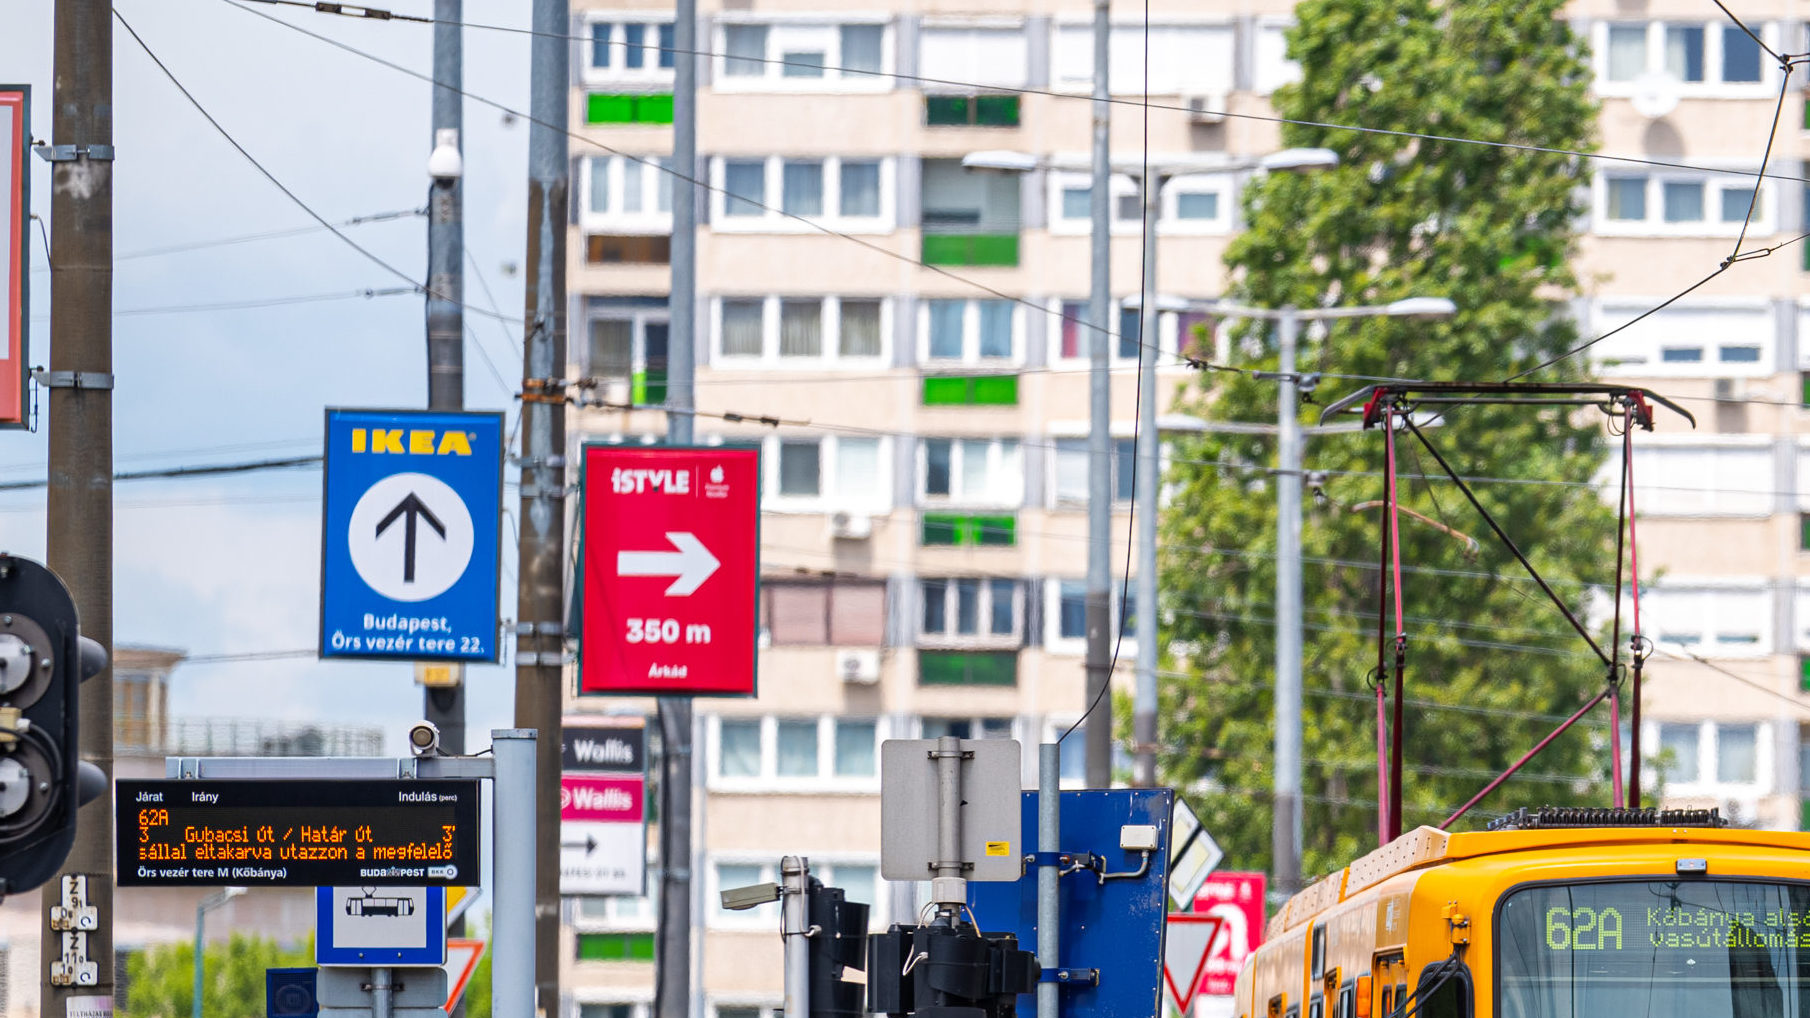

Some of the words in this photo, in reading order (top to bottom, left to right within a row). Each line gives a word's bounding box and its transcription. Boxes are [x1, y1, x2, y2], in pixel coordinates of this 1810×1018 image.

[352, 428, 472, 456] IKEA
[611, 467, 690, 494] iSTYLE
[363, 613, 452, 634] Budapest,
[626, 618, 680, 644] 350
[686, 624, 711, 644] m
[331, 629, 361, 650] Örs
[366, 635, 413, 651] vezér
[418, 638, 456, 652] tere
[573, 739, 634, 764] Wallis
[136, 791, 164, 803] Járat
[191, 791, 219, 805] Irány
[398, 791, 438, 803] Indulás
[573, 787, 634, 811] Wallis
[138, 809, 169, 826] 62A
[139, 826, 150, 843] 3
[184, 826, 249, 843] Gubacsi
[256, 825, 275, 843] út
[283, 827, 293, 841] /
[300, 825, 347, 843] Határ
[355, 825, 373, 843] út
[442, 825, 456, 843] 3'
[139, 843, 187, 860] sállal
[195, 843, 272, 860] eltakarva
[280, 843, 348, 860] utazzon
[355, 848, 365, 860] a
[373, 842, 453, 861] megfelelő
[137, 865, 157, 878] Örs
[160, 867, 189, 878] vezér
[192, 867, 215, 878] tere
[217, 867, 229, 878] M
[232, 867, 288, 880] (Kőbánya)
[69, 881, 79, 895] Z
[1546, 907, 1622, 950] 62A
[70, 937, 80, 951] Z
